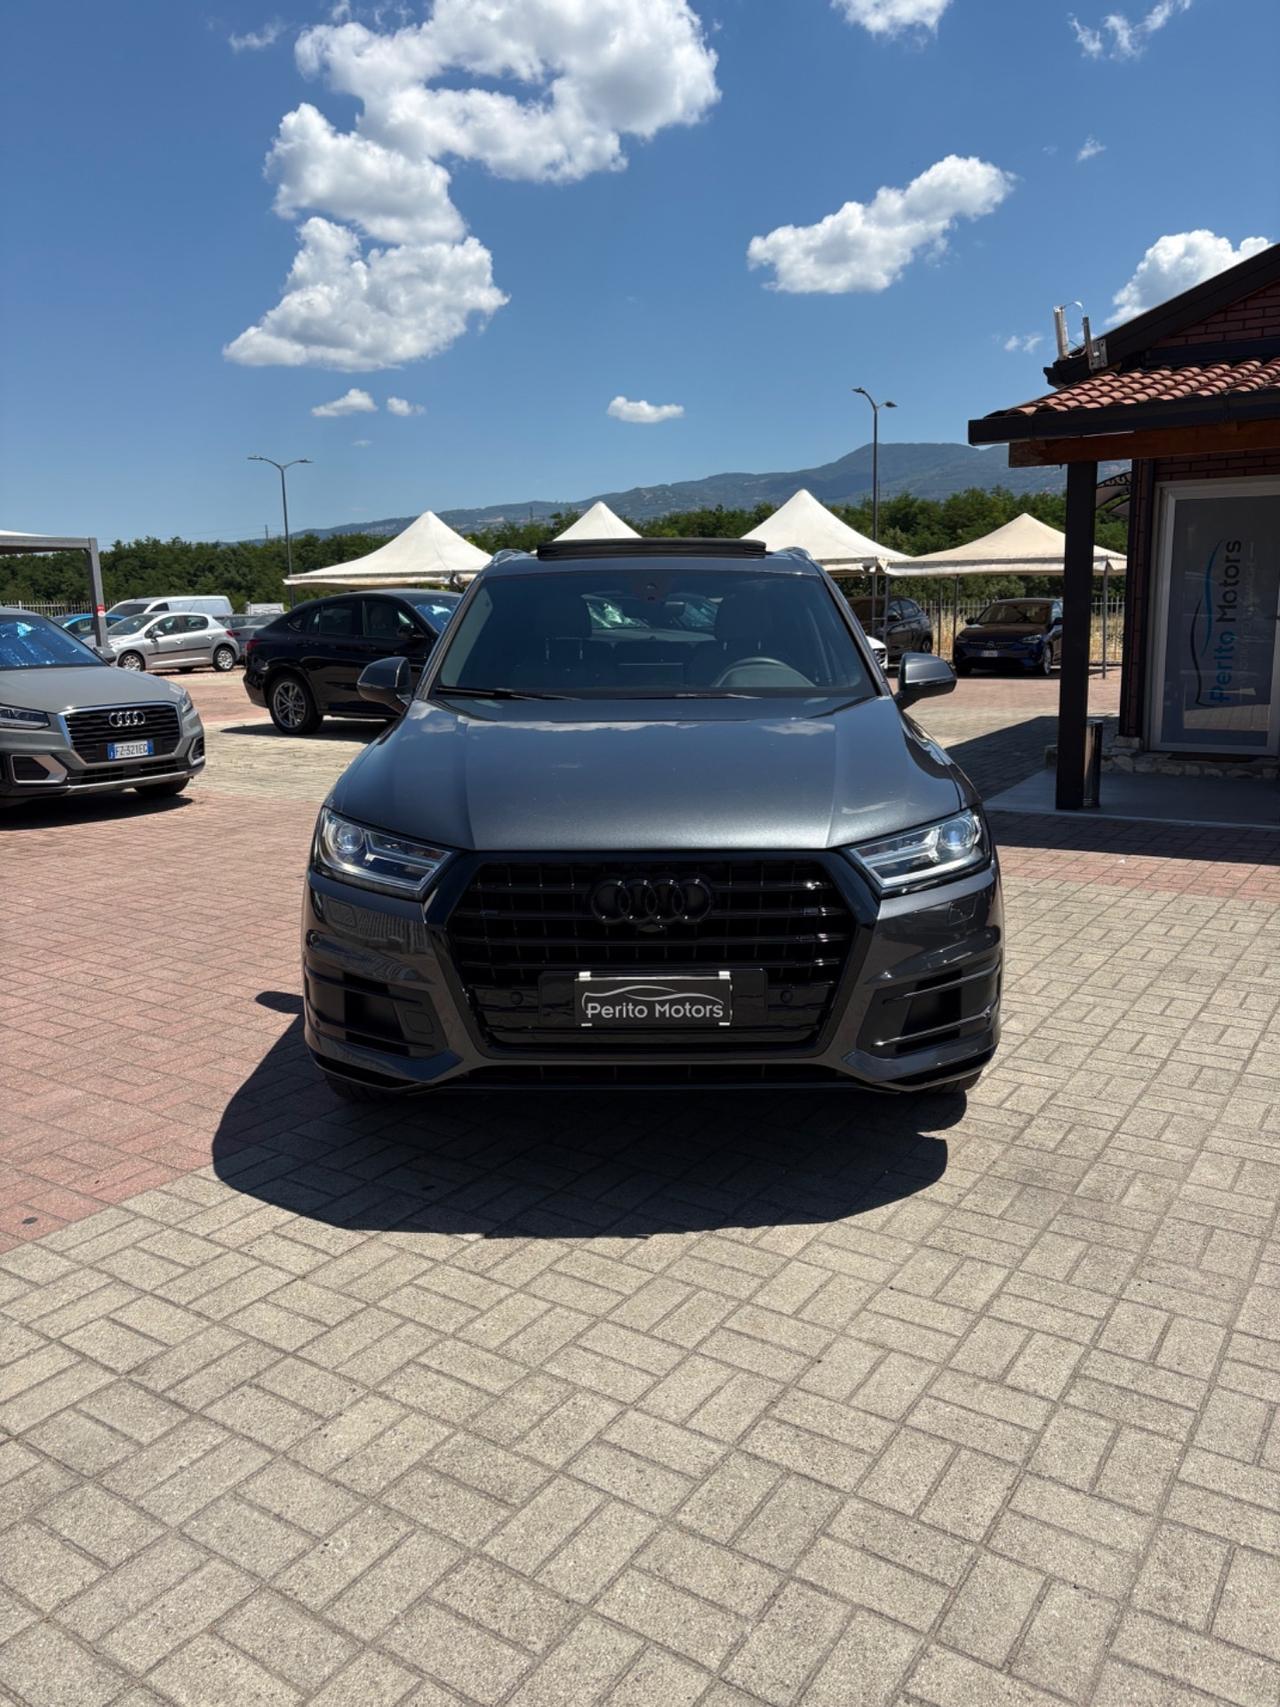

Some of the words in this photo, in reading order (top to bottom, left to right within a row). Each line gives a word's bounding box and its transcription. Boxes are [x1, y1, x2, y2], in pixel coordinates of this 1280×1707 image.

[1216, 540, 1241, 622] Motors
[1209, 631, 1235, 702] Perito
[586, 1002, 648, 1018] Perito
[655, 1002, 724, 1018] Motors
